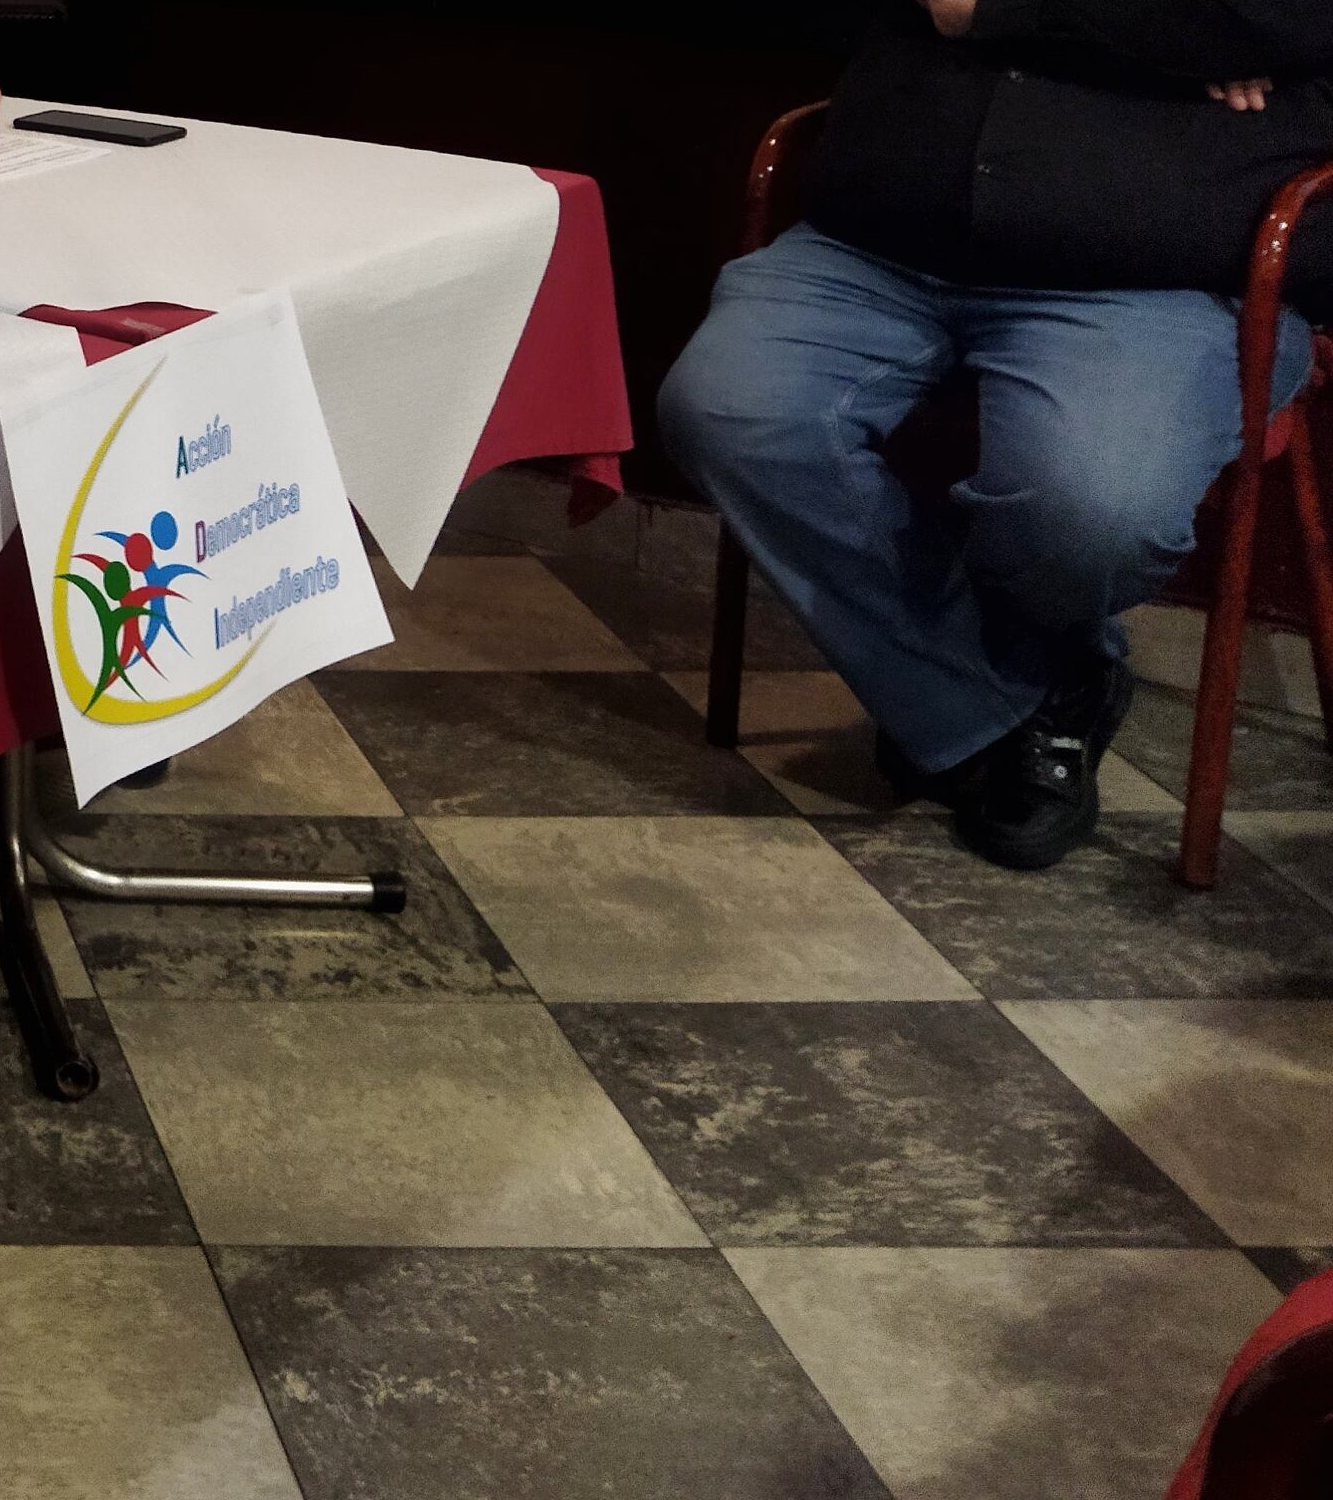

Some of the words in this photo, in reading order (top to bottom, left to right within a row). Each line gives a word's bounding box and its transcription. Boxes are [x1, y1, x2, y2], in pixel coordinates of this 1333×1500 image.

[176, 414, 232, 479] Acción
[194, 482, 301, 564] Democrática
[213, 555, 340, 650] Independiente
